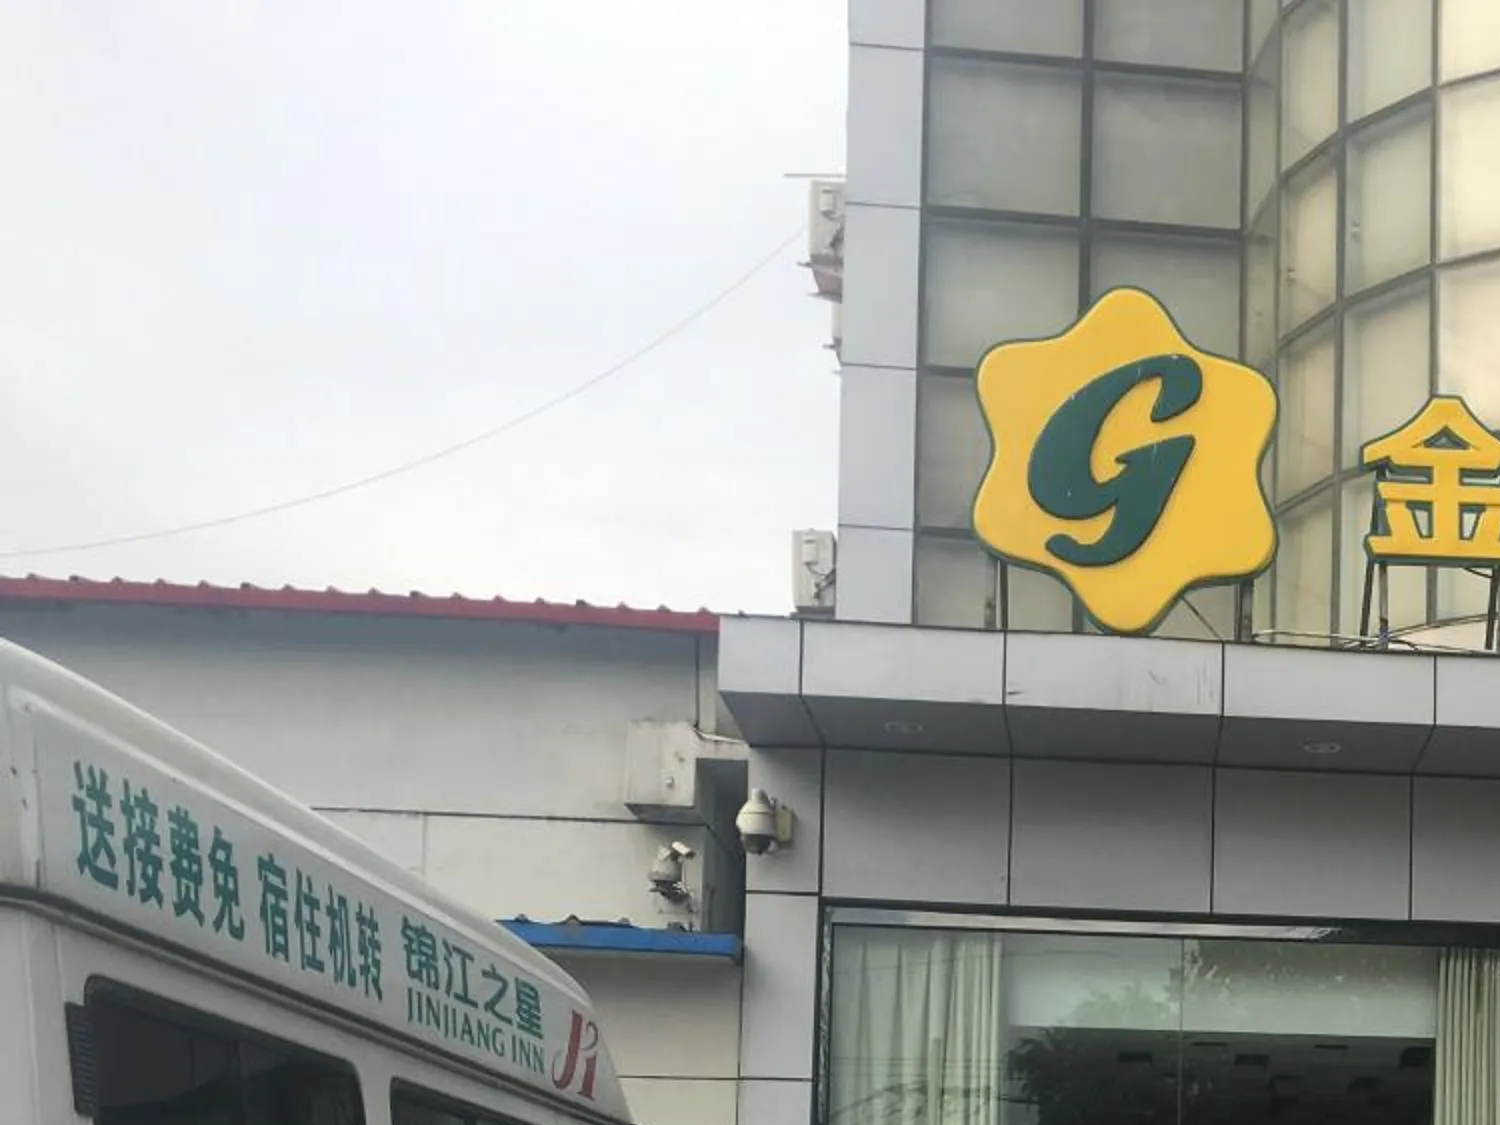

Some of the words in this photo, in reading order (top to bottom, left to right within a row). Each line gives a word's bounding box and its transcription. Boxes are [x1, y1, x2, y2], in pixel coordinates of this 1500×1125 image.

[401, 915, 544, 1040] 锦江之星
[407, 987, 506, 1058] JINJIANG
[511, 1034, 545, 1075] INN
